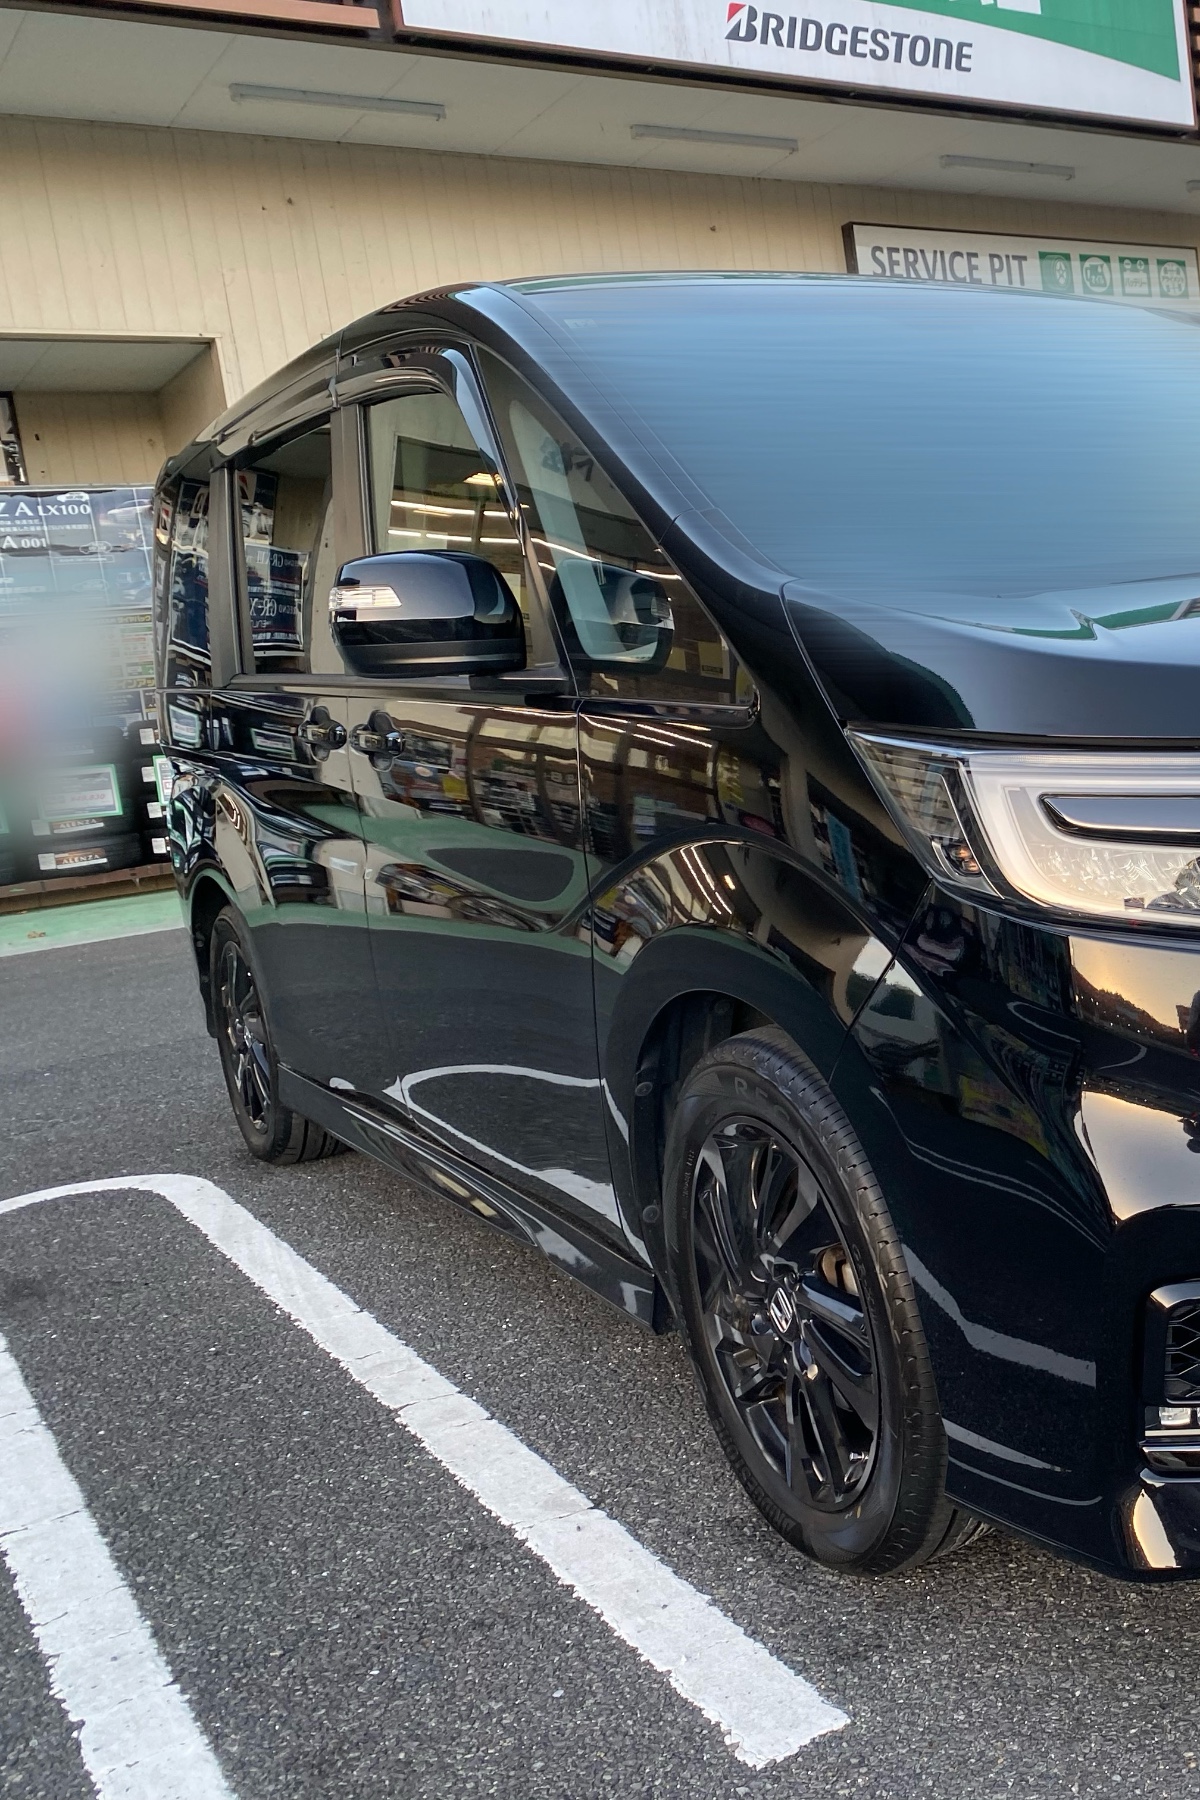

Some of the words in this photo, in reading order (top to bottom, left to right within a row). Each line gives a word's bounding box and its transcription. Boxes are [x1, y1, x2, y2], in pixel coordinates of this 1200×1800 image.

[725, 2, 973, 73] BRIDGESTONE
[870, 246, 980, 284] SERVICE
[989, 252, 1028, 287] PIT
[38, 504, 91, 516] LX100
[21, 538, 47, 548] 001
[62, 854, 101, 865] ALENZA
